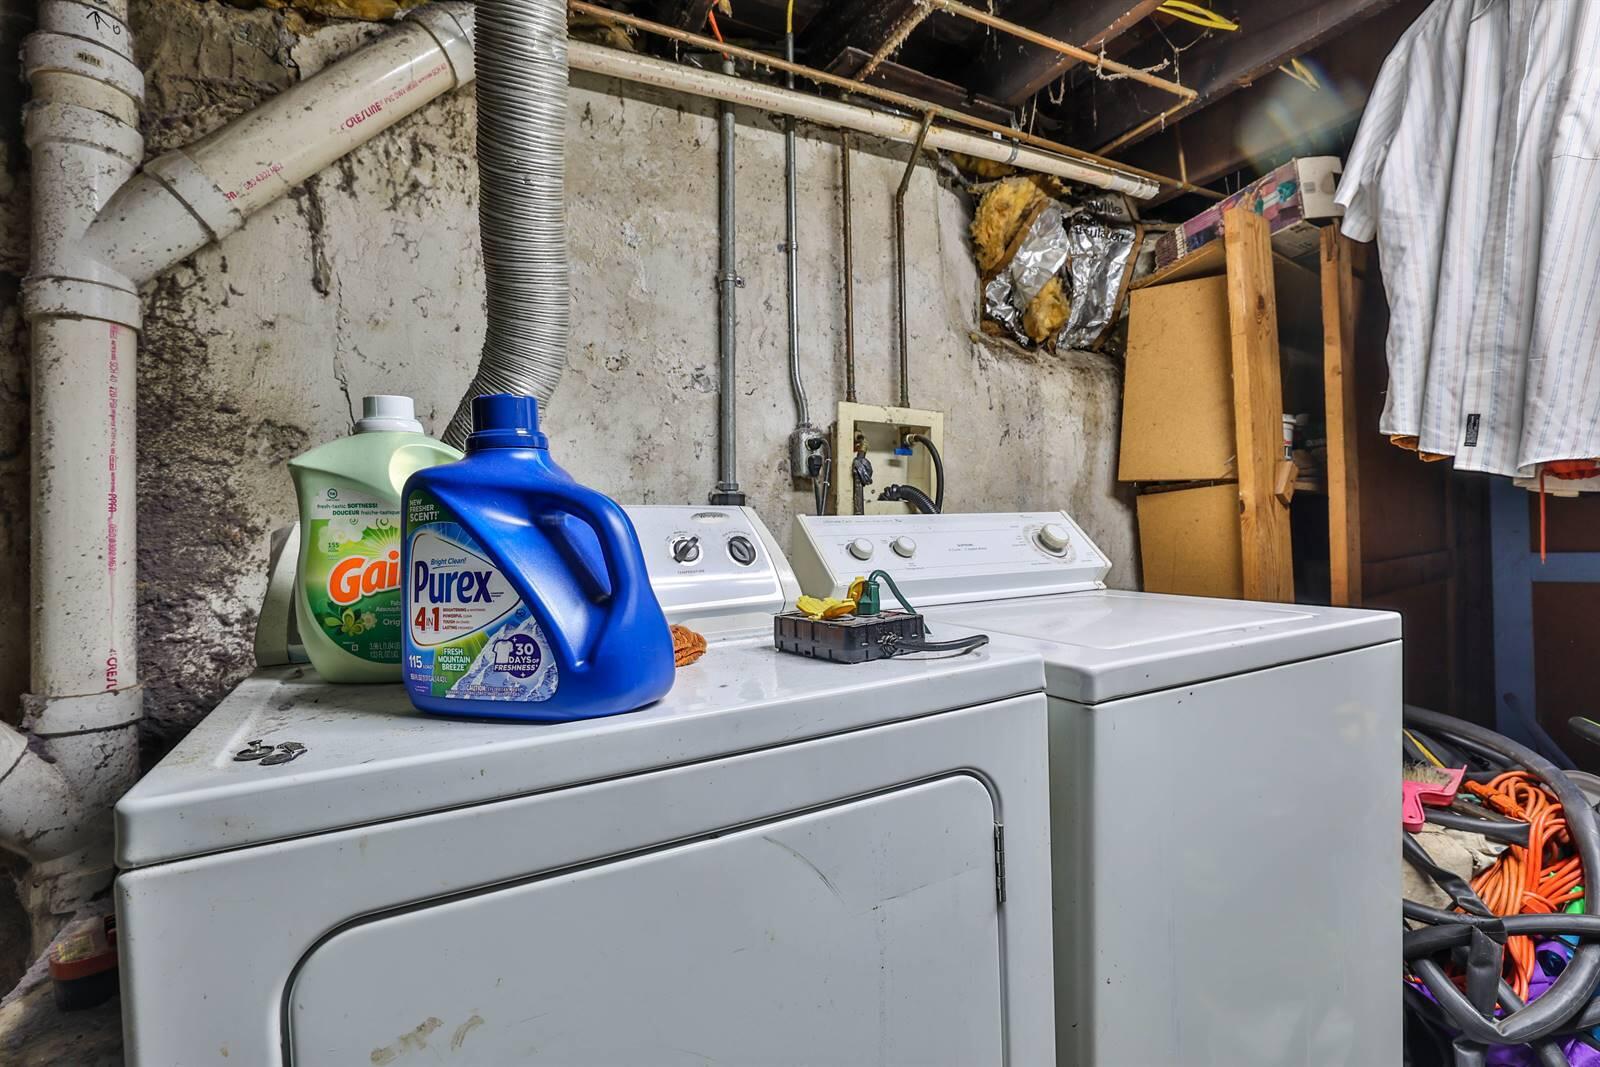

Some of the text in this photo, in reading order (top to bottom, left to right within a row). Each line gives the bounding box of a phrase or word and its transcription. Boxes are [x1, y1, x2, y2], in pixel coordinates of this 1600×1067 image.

[431, 558, 447, 567] Bright
[329, 550, 400, 604] Gai
[415, 561, 492, 603] Purex
[515, 643, 535, 656] 30
[409, 656, 422, 668] 115
[438, 656, 471, 664] MOUNTAIN
[508, 656, 532, 664] DAYS
[105, 656, 118, 690] CRESL
